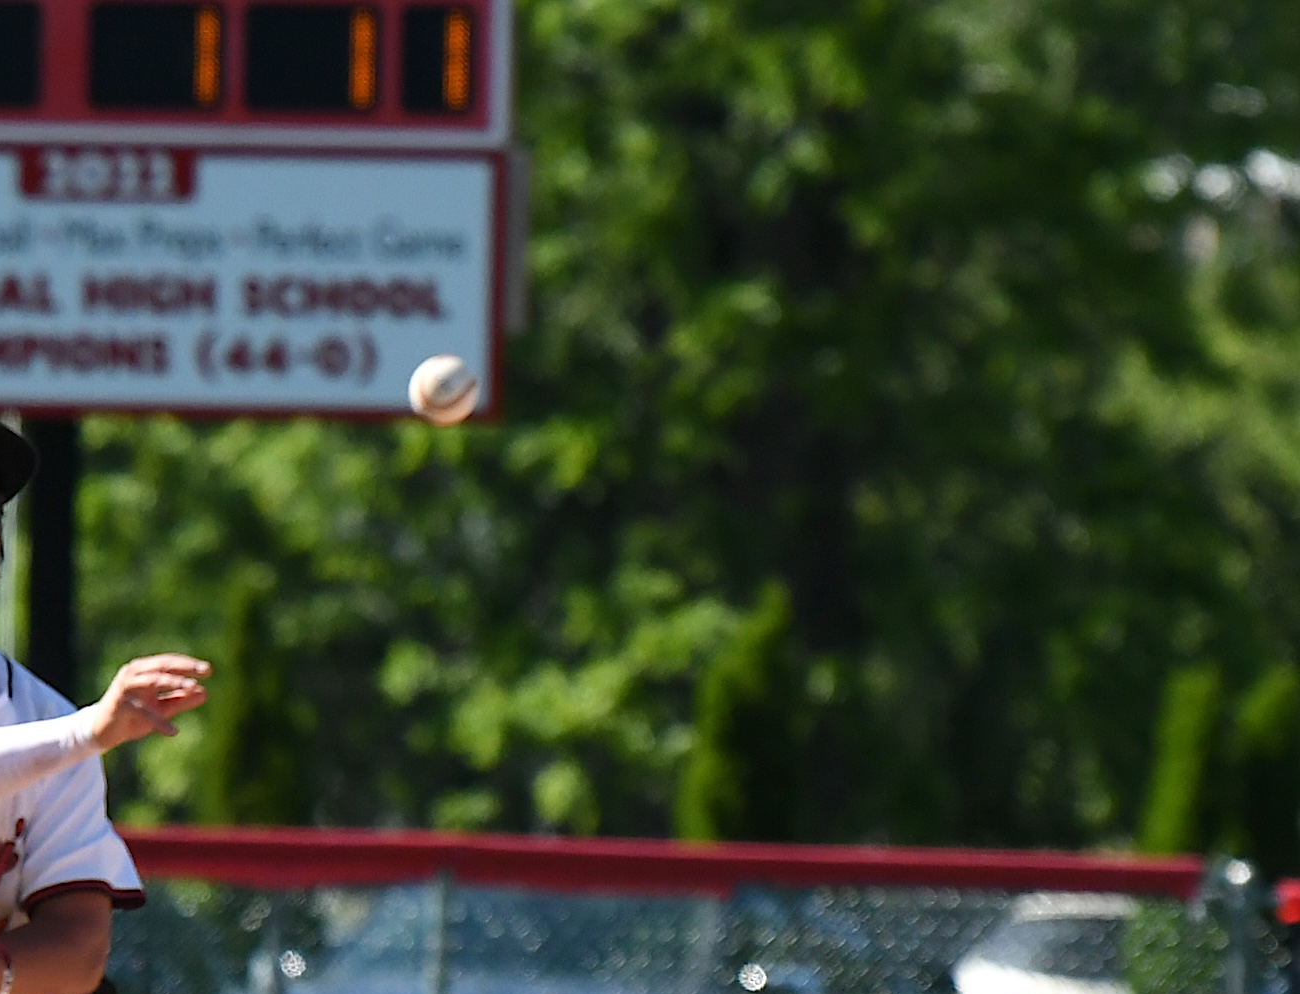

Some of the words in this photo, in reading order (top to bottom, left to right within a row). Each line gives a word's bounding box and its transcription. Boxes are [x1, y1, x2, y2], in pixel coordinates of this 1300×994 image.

[194, 7, 221, 107] 1
[349, 8, 376, 110] 1
[443, 8, 471, 111] 1
[81, 273, 218, 318] HIGH
[243, 275, 448, 322] SCHOOL
[198, 331, 380, 385] (44-0)
